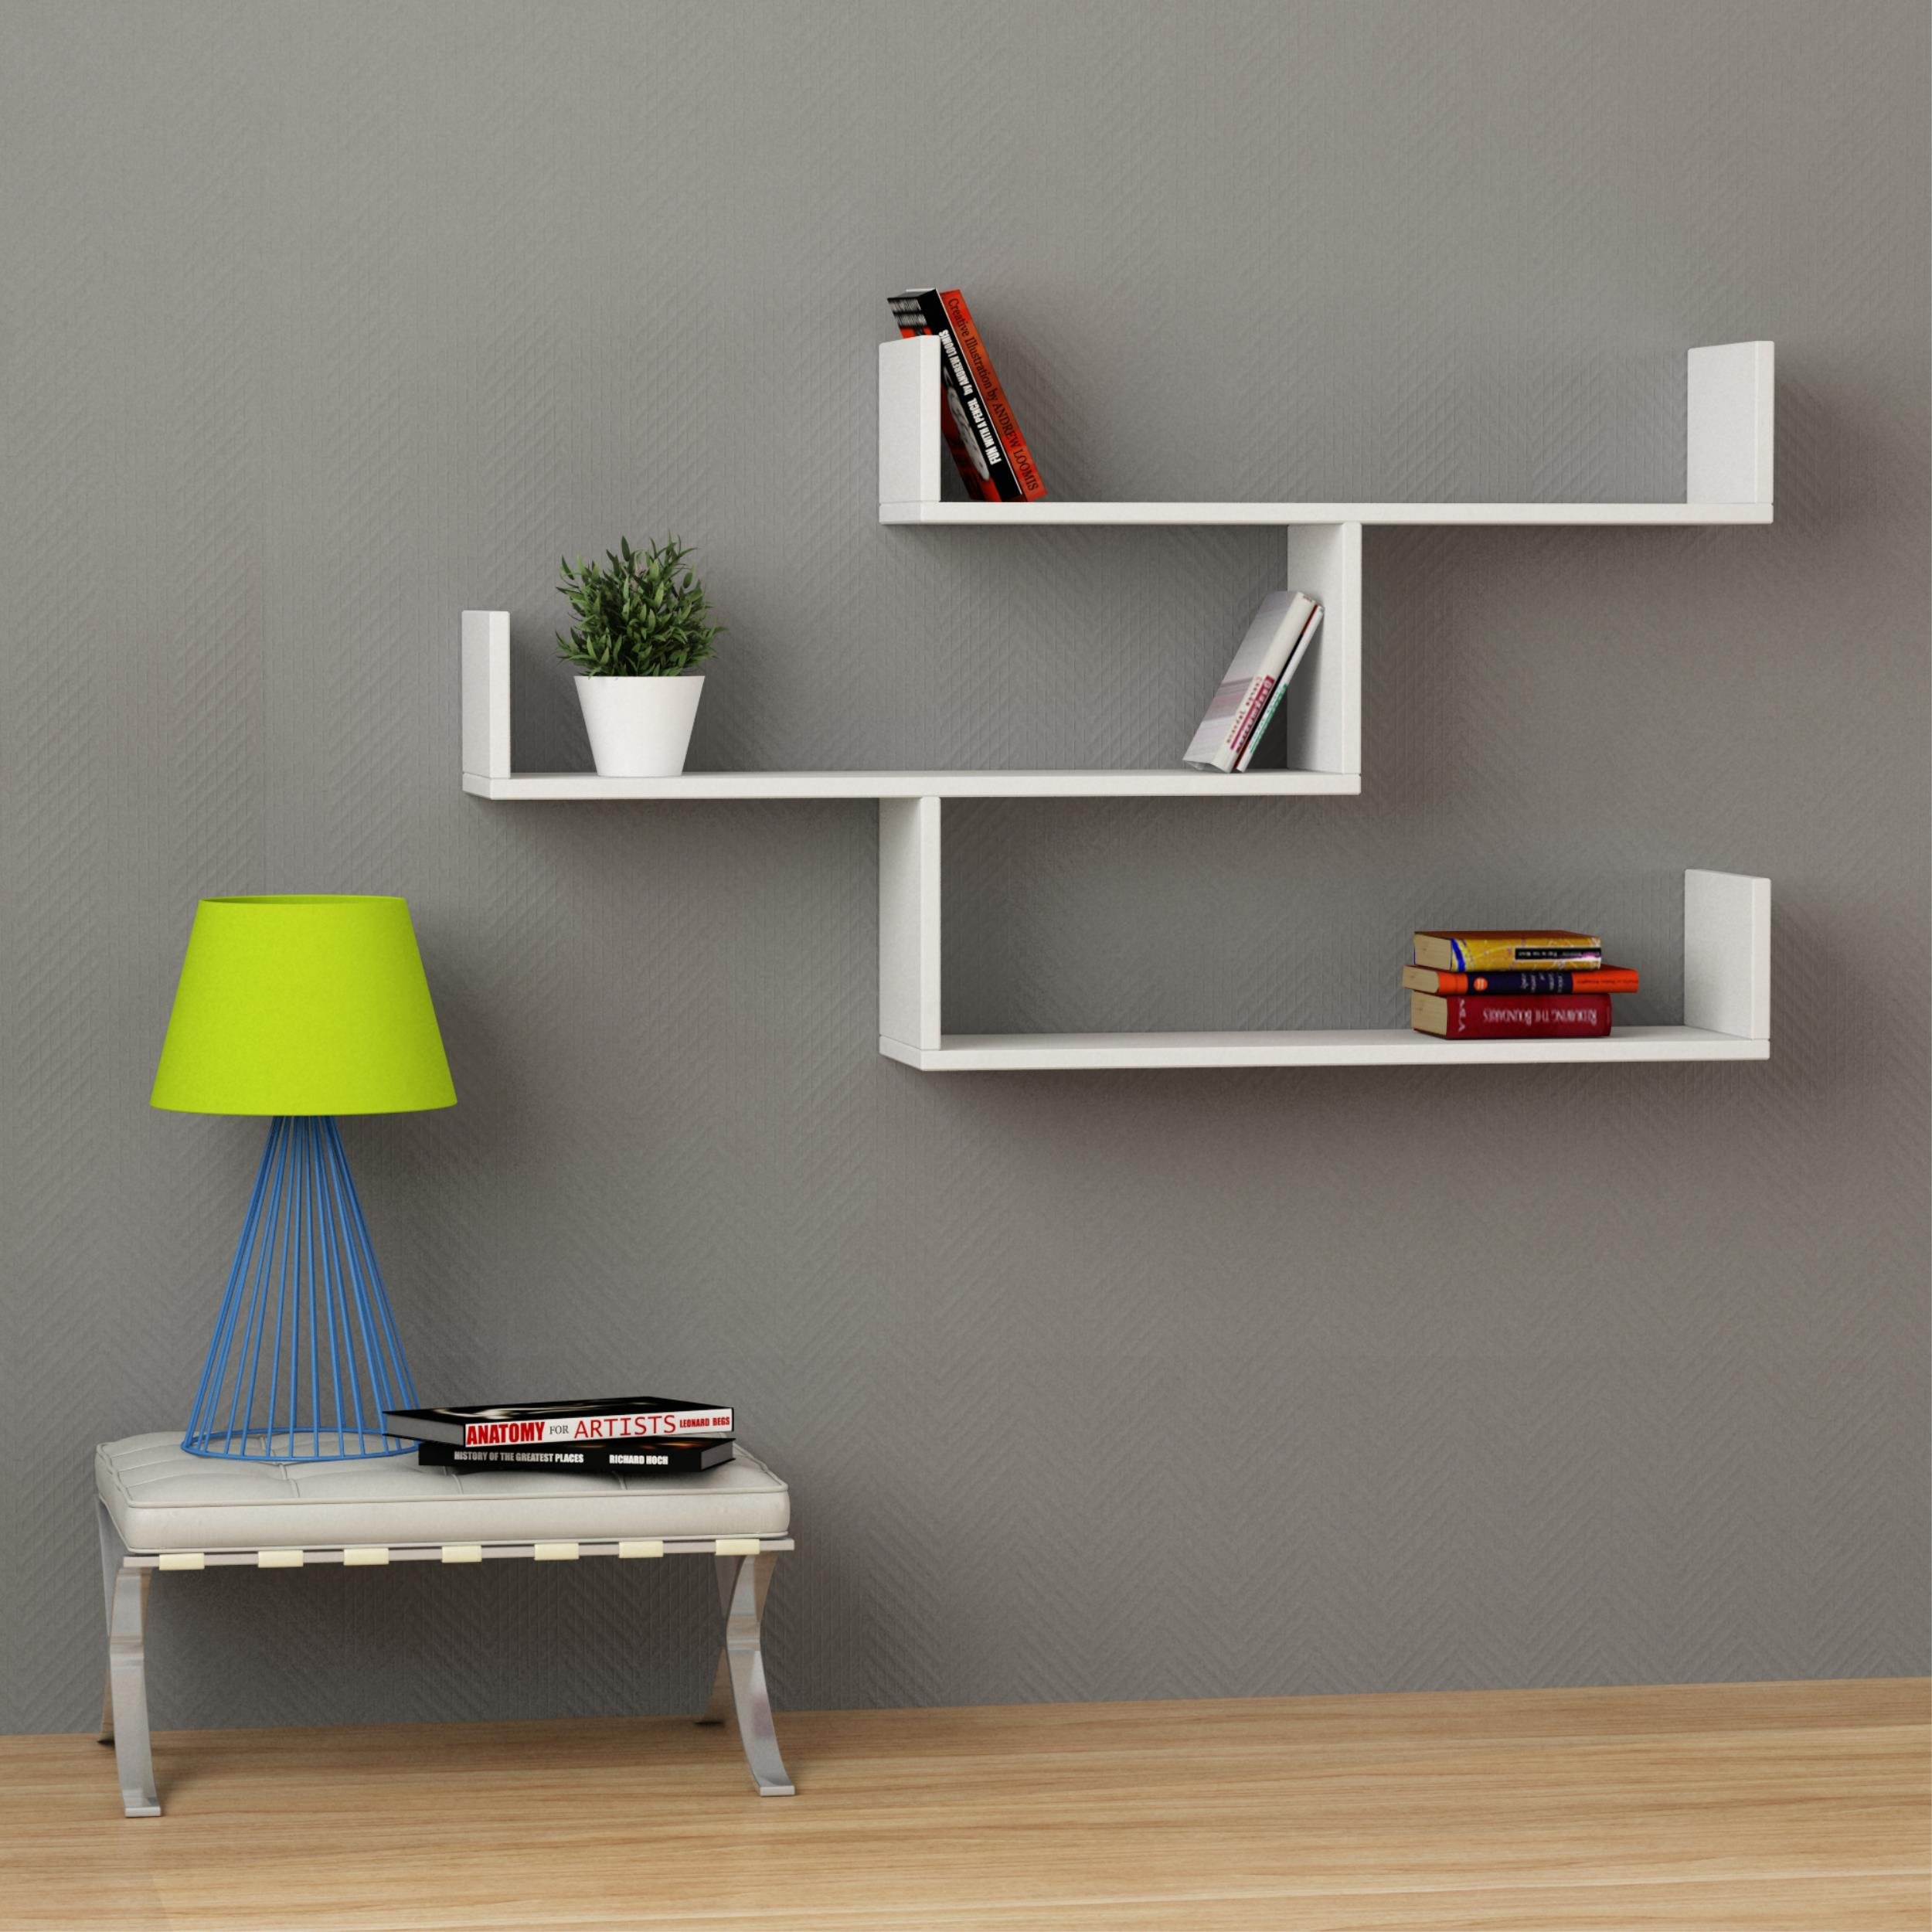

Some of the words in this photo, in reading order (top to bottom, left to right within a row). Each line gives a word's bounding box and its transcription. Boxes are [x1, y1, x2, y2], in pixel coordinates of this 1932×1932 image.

[938, 328, 957, 358] LOOMIS
[949, 355, 971, 386] ANDREW
[947, 298, 970, 337] Creative
[964, 337, 992, 389] Illustration
[986, 387, 998, 401] by
[992, 402, 1021, 448] ANDREW
[1012, 448, 1039, 492] LOOMIS
[962, 384, 974, 396] by
[967, 397, 985, 424] PENCIL
[977, 420, 988, 429] A
[978, 427, 995, 448] WITH
[985, 446, 1002, 465] FUN
[466, 1421, 546, 1445] ANATOMY
[549, 1425, 569, 1435] FOR
[573, 1414, 676, 1440] ARTISTS
[679, 1417, 709, 1428] LEONARD
[713, 1417, 730, 1426] BEGS
[454, 1450, 488, 1461] HISTORY
[488, 1452, 499, 1461] OF
[500, 1453, 515, 1461] THE
[515, 1453, 554, 1463] GREATEST
[555, 1453, 584, 1463] PLACES
[609, 1454, 645, 1464] RICHARD
[646, 1455, 668, 1465] HOCH
